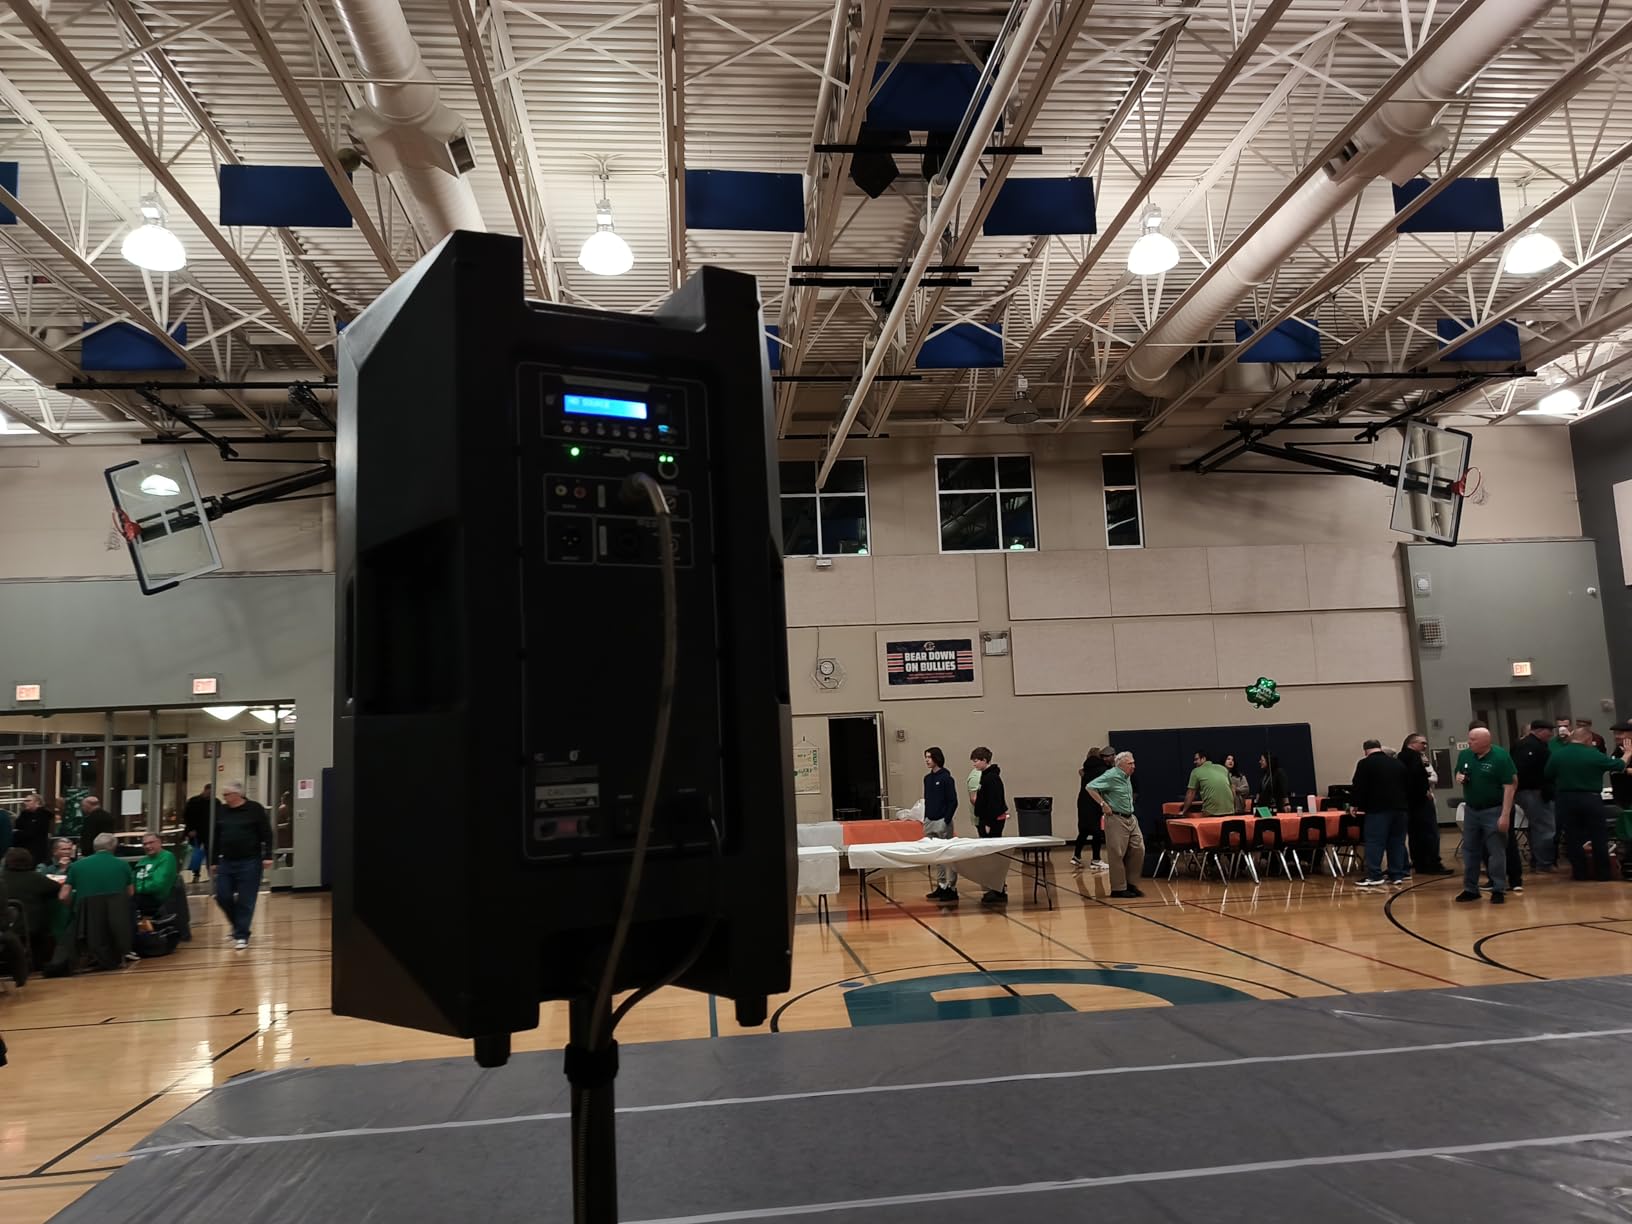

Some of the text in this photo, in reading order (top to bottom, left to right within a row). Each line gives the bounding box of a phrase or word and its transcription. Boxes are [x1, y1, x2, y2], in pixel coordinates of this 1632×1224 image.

[904, 651, 955, 661] BEAR DOWN
[905, 661, 956, 672] ON BULLIES
[1515, 664, 1528, 674] EXIT
[195, 681, 214, 692] EXIT
[18, 687, 37, 698] EXIT
